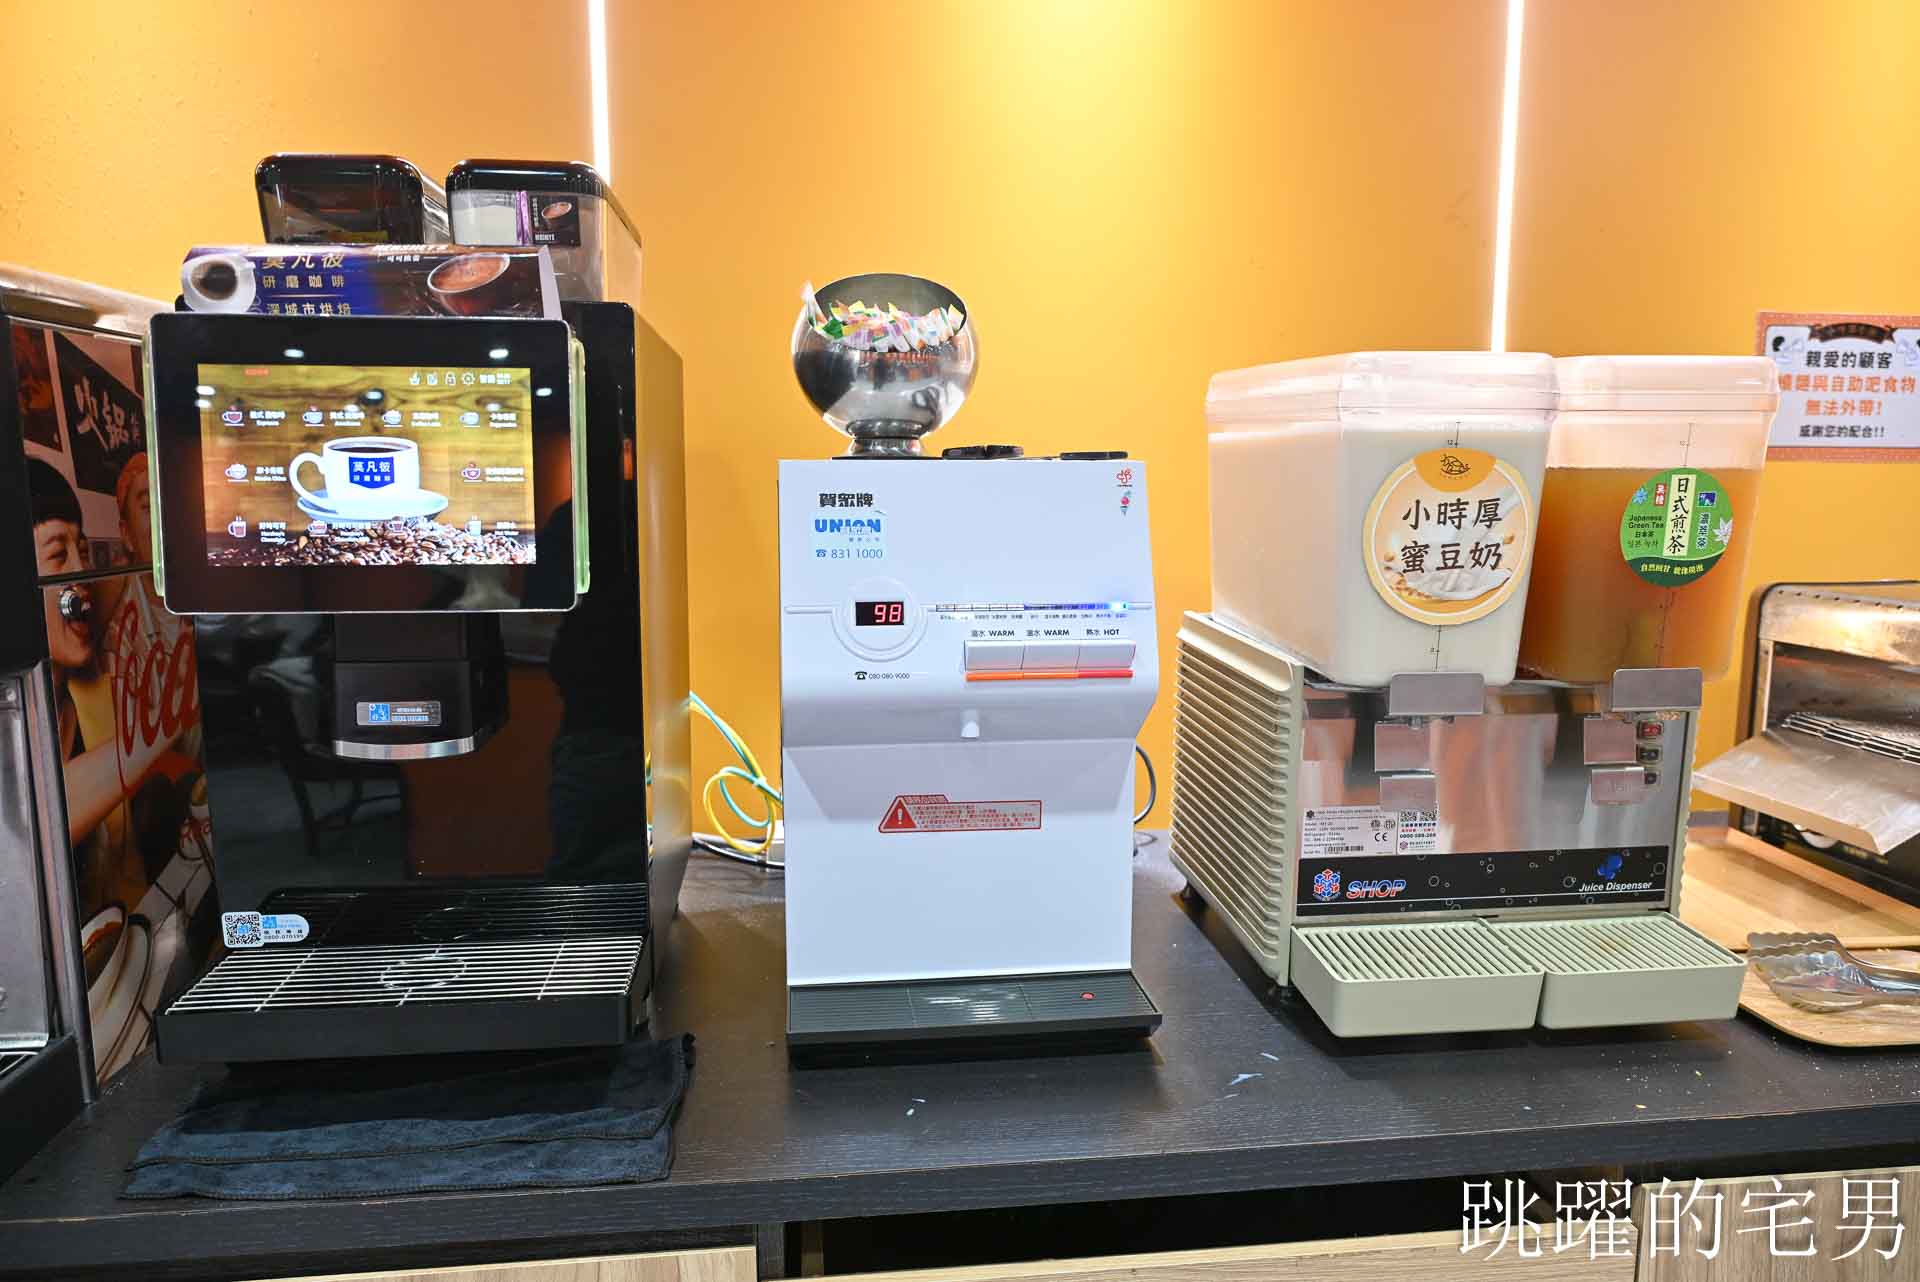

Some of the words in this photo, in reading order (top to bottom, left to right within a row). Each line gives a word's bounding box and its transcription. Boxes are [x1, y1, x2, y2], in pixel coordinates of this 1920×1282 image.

[262, 275, 345, 288] 研磨咖啡
[1806, 351, 1893, 369] 親愛的顧客
[1402, 497, 1503, 531] 小時厚
[1629, 514, 1663, 523] Japanese
[1667, 477, 1690, 554] 日式煎茶
[815, 519, 881, 533] UNION
[831, 549, 850, 559] 831
[856, 549, 883, 559] 1000
[1400, 540, 1503, 574] 蜜豆奶
[874, 604, 902, 623] 98
[989, 629, 1015, 637] WARM
[1103, 628, 1120, 636] HOT
[1346, 879, 1406, 899] SHOP
[1578, 882, 1604, 892] Juice
[1605, 881, 1652, 891] Dispenser
